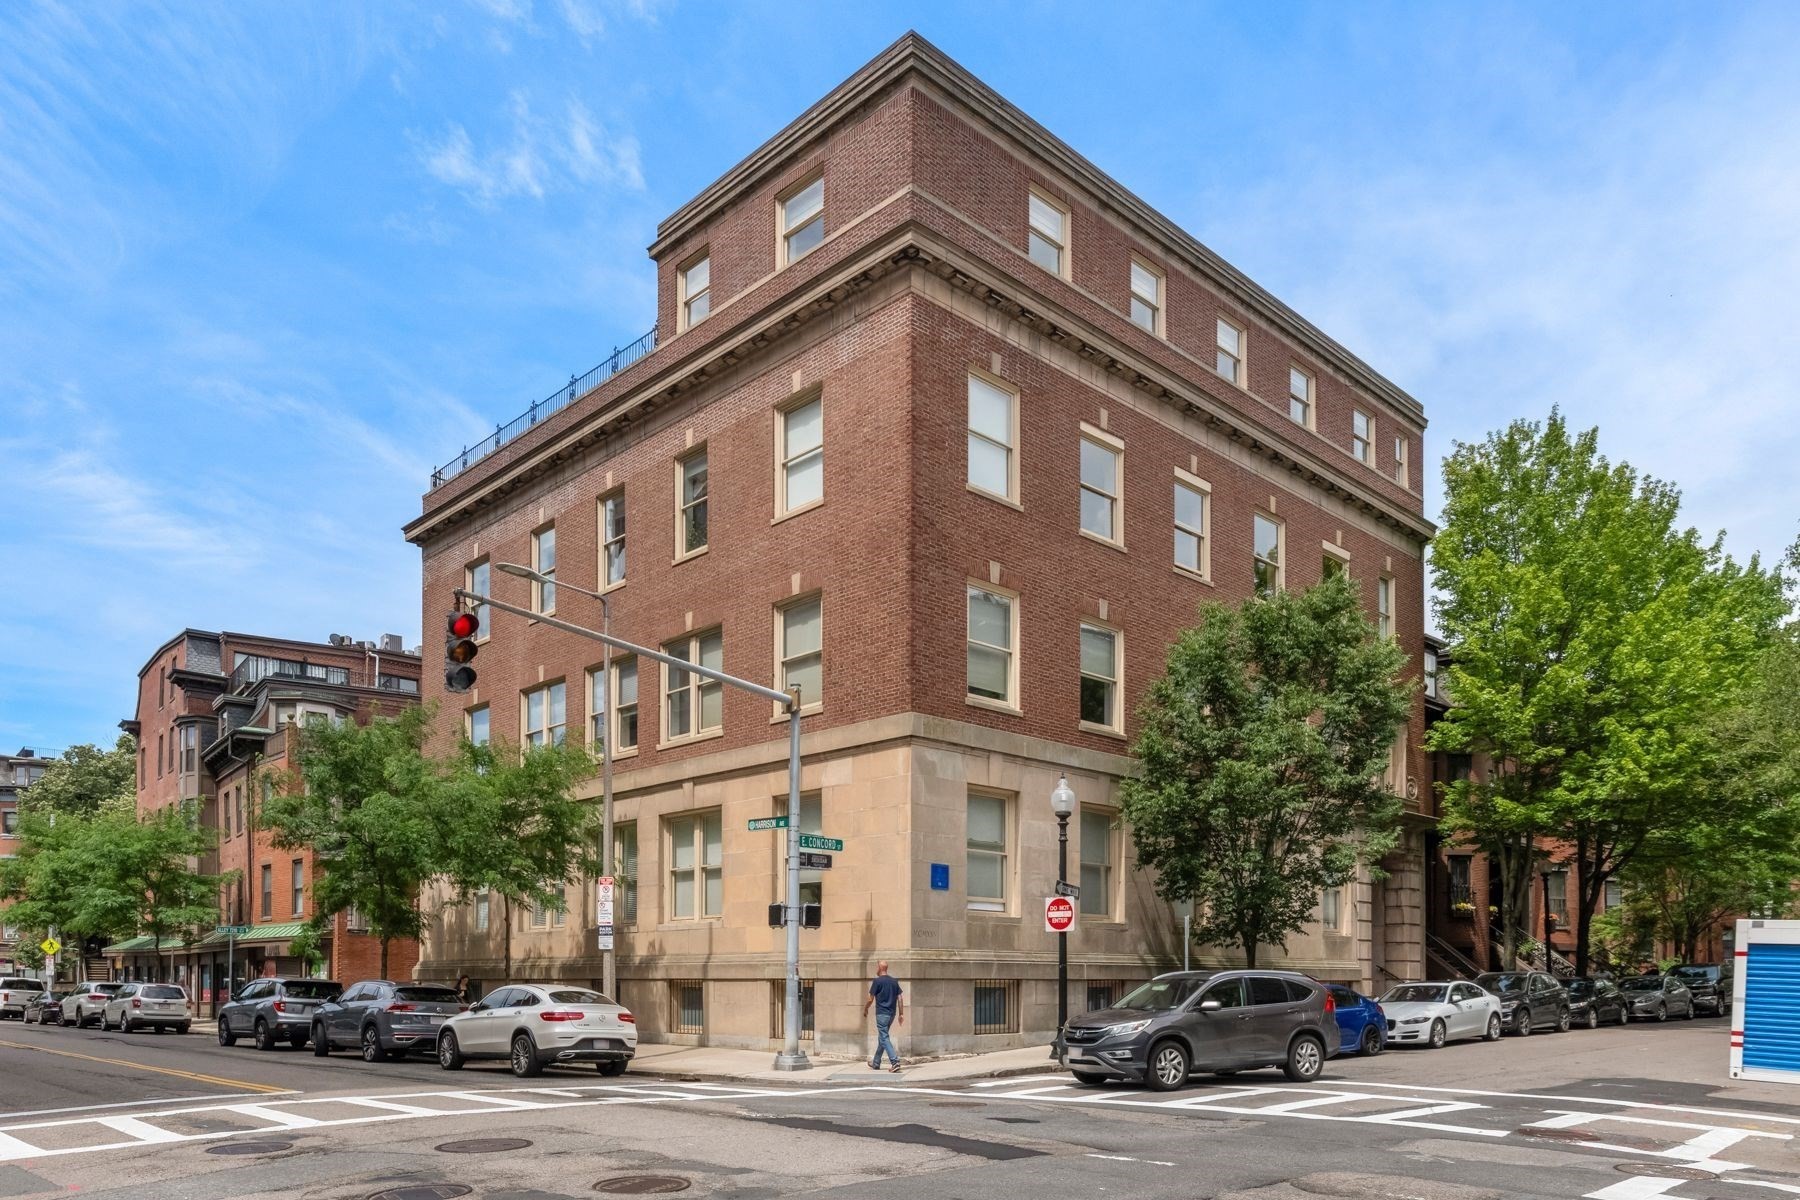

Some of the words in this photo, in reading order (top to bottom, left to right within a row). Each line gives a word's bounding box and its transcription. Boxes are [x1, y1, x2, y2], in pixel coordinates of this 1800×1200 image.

[755, 819, 776, 829] HARRISON
[801, 836, 807, 846] E.
[808, 837, 836, 849] CONCORD
